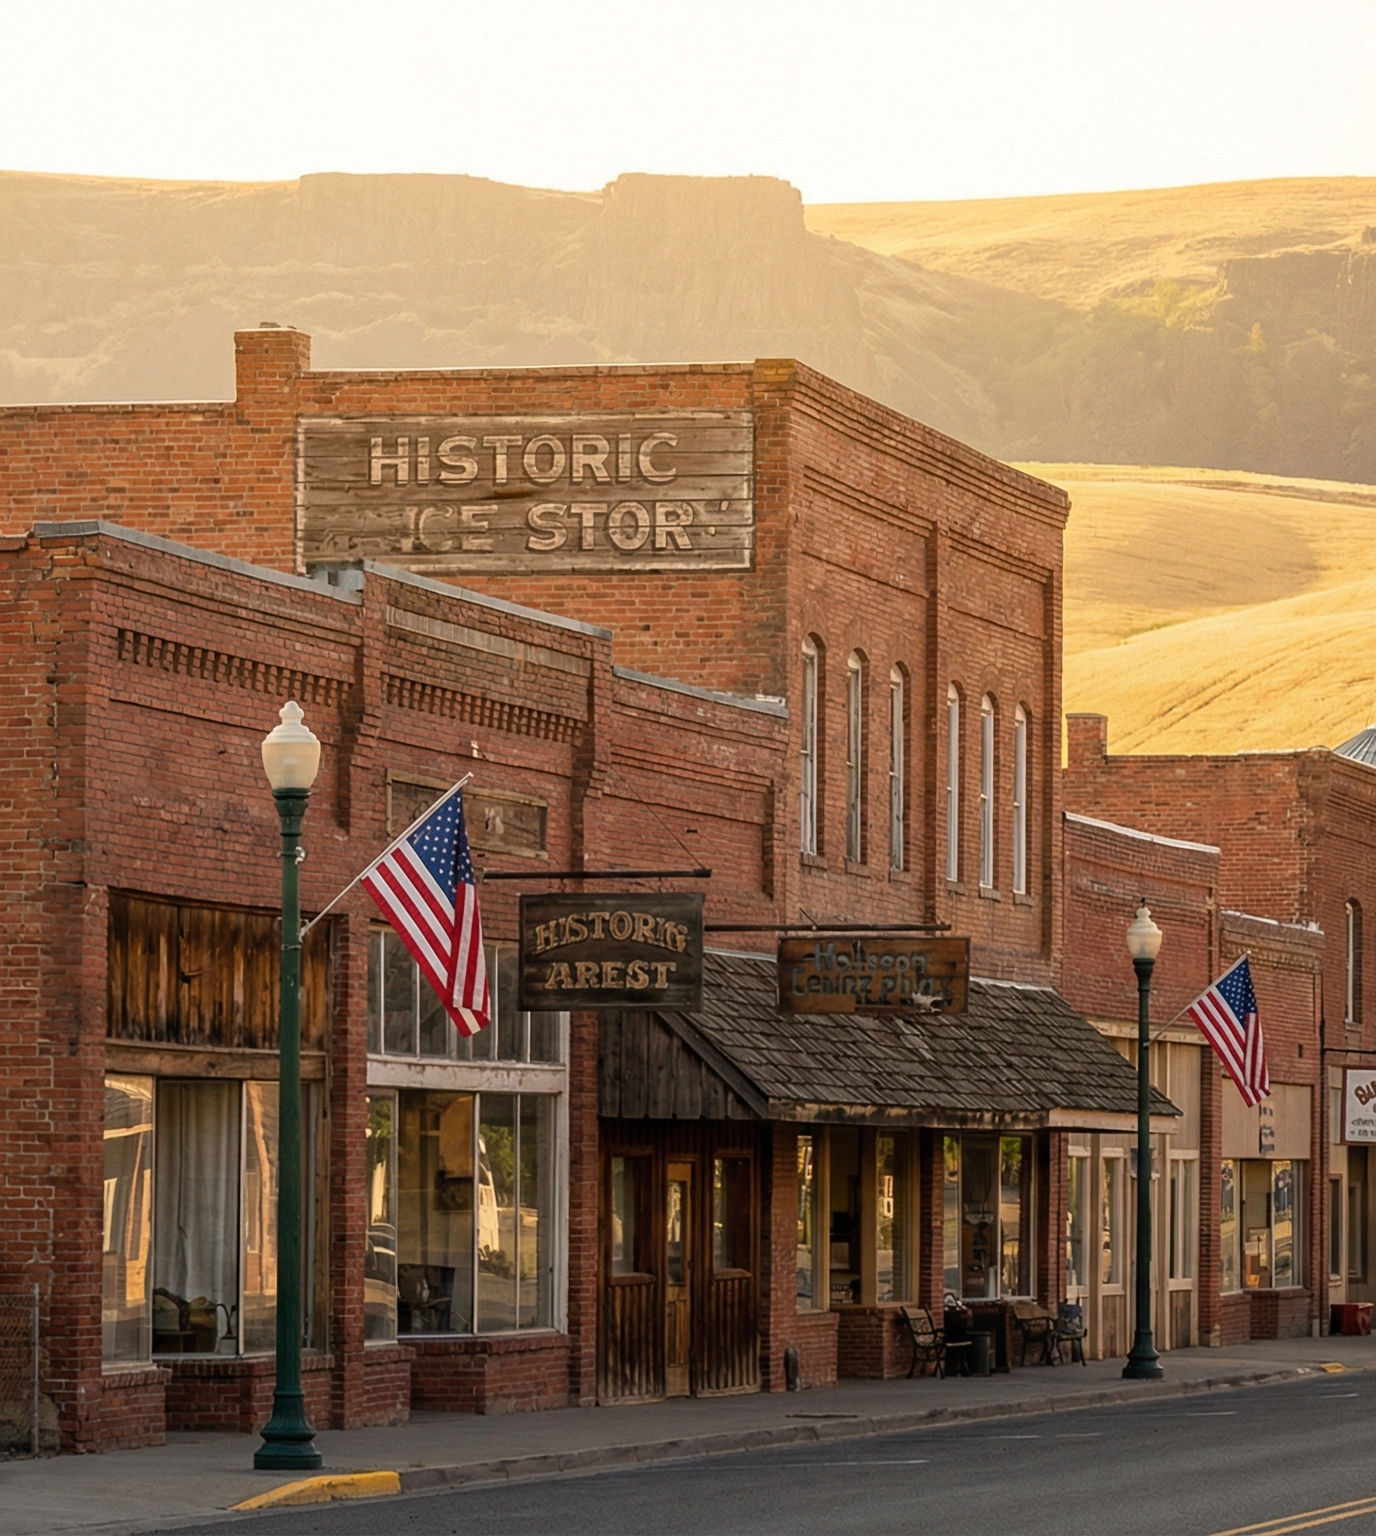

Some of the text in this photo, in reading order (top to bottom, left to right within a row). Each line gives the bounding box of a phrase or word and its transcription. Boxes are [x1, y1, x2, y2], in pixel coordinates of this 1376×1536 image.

[369, 432, 678, 485] HISTORIC
[525, 500, 729, 551] STOR
[544, 960, 677, 989] AREST
